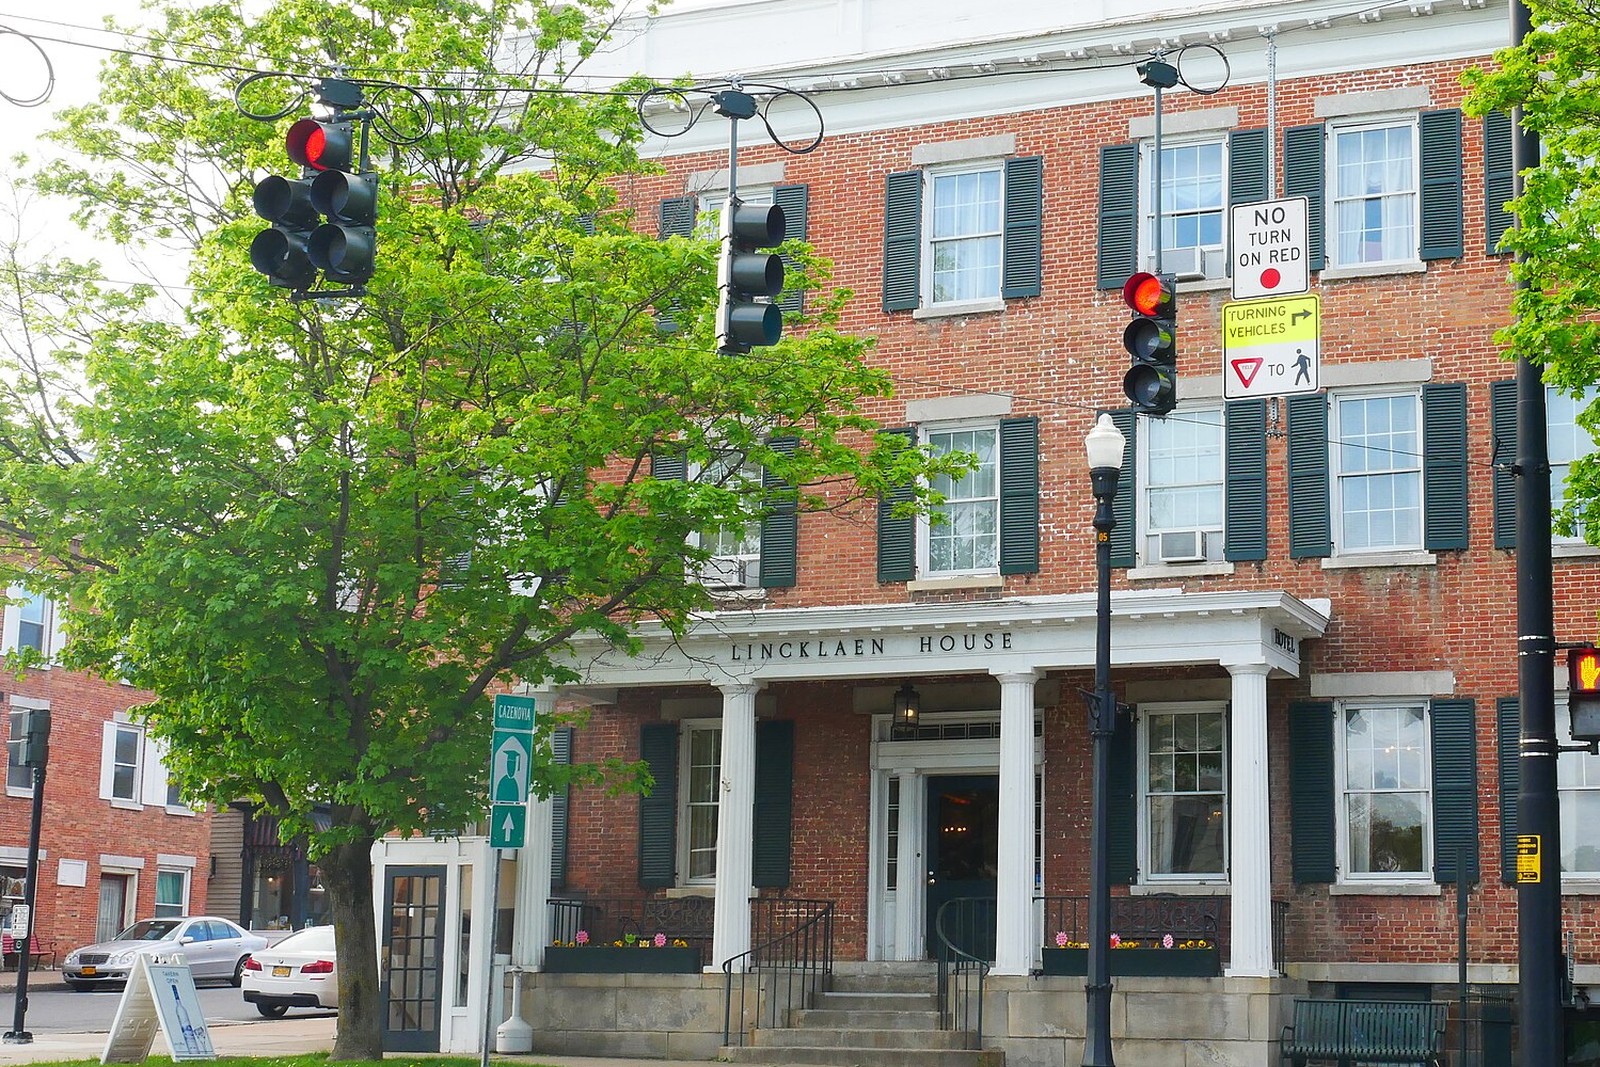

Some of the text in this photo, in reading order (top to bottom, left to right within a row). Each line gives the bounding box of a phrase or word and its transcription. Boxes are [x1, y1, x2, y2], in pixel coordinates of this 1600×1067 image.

[1254, 207, 1285, 227] NO
[1248, 228, 1291, 246] TURN
[1239, 247, 1301, 267] ON RED
[1228, 305, 1286, 321] TURNING
[1229, 322, 1286, 338] VEHICLES
[1267, 363, 1285, 376] TO
[1098, 532, 1108, 542] 05
[731, 632, 1012, 660] LINCKLAEN HOUSE
[1275, 628, 1296, 653] HOTEL
[498, 704, 531, 721] CAZENOVIA
